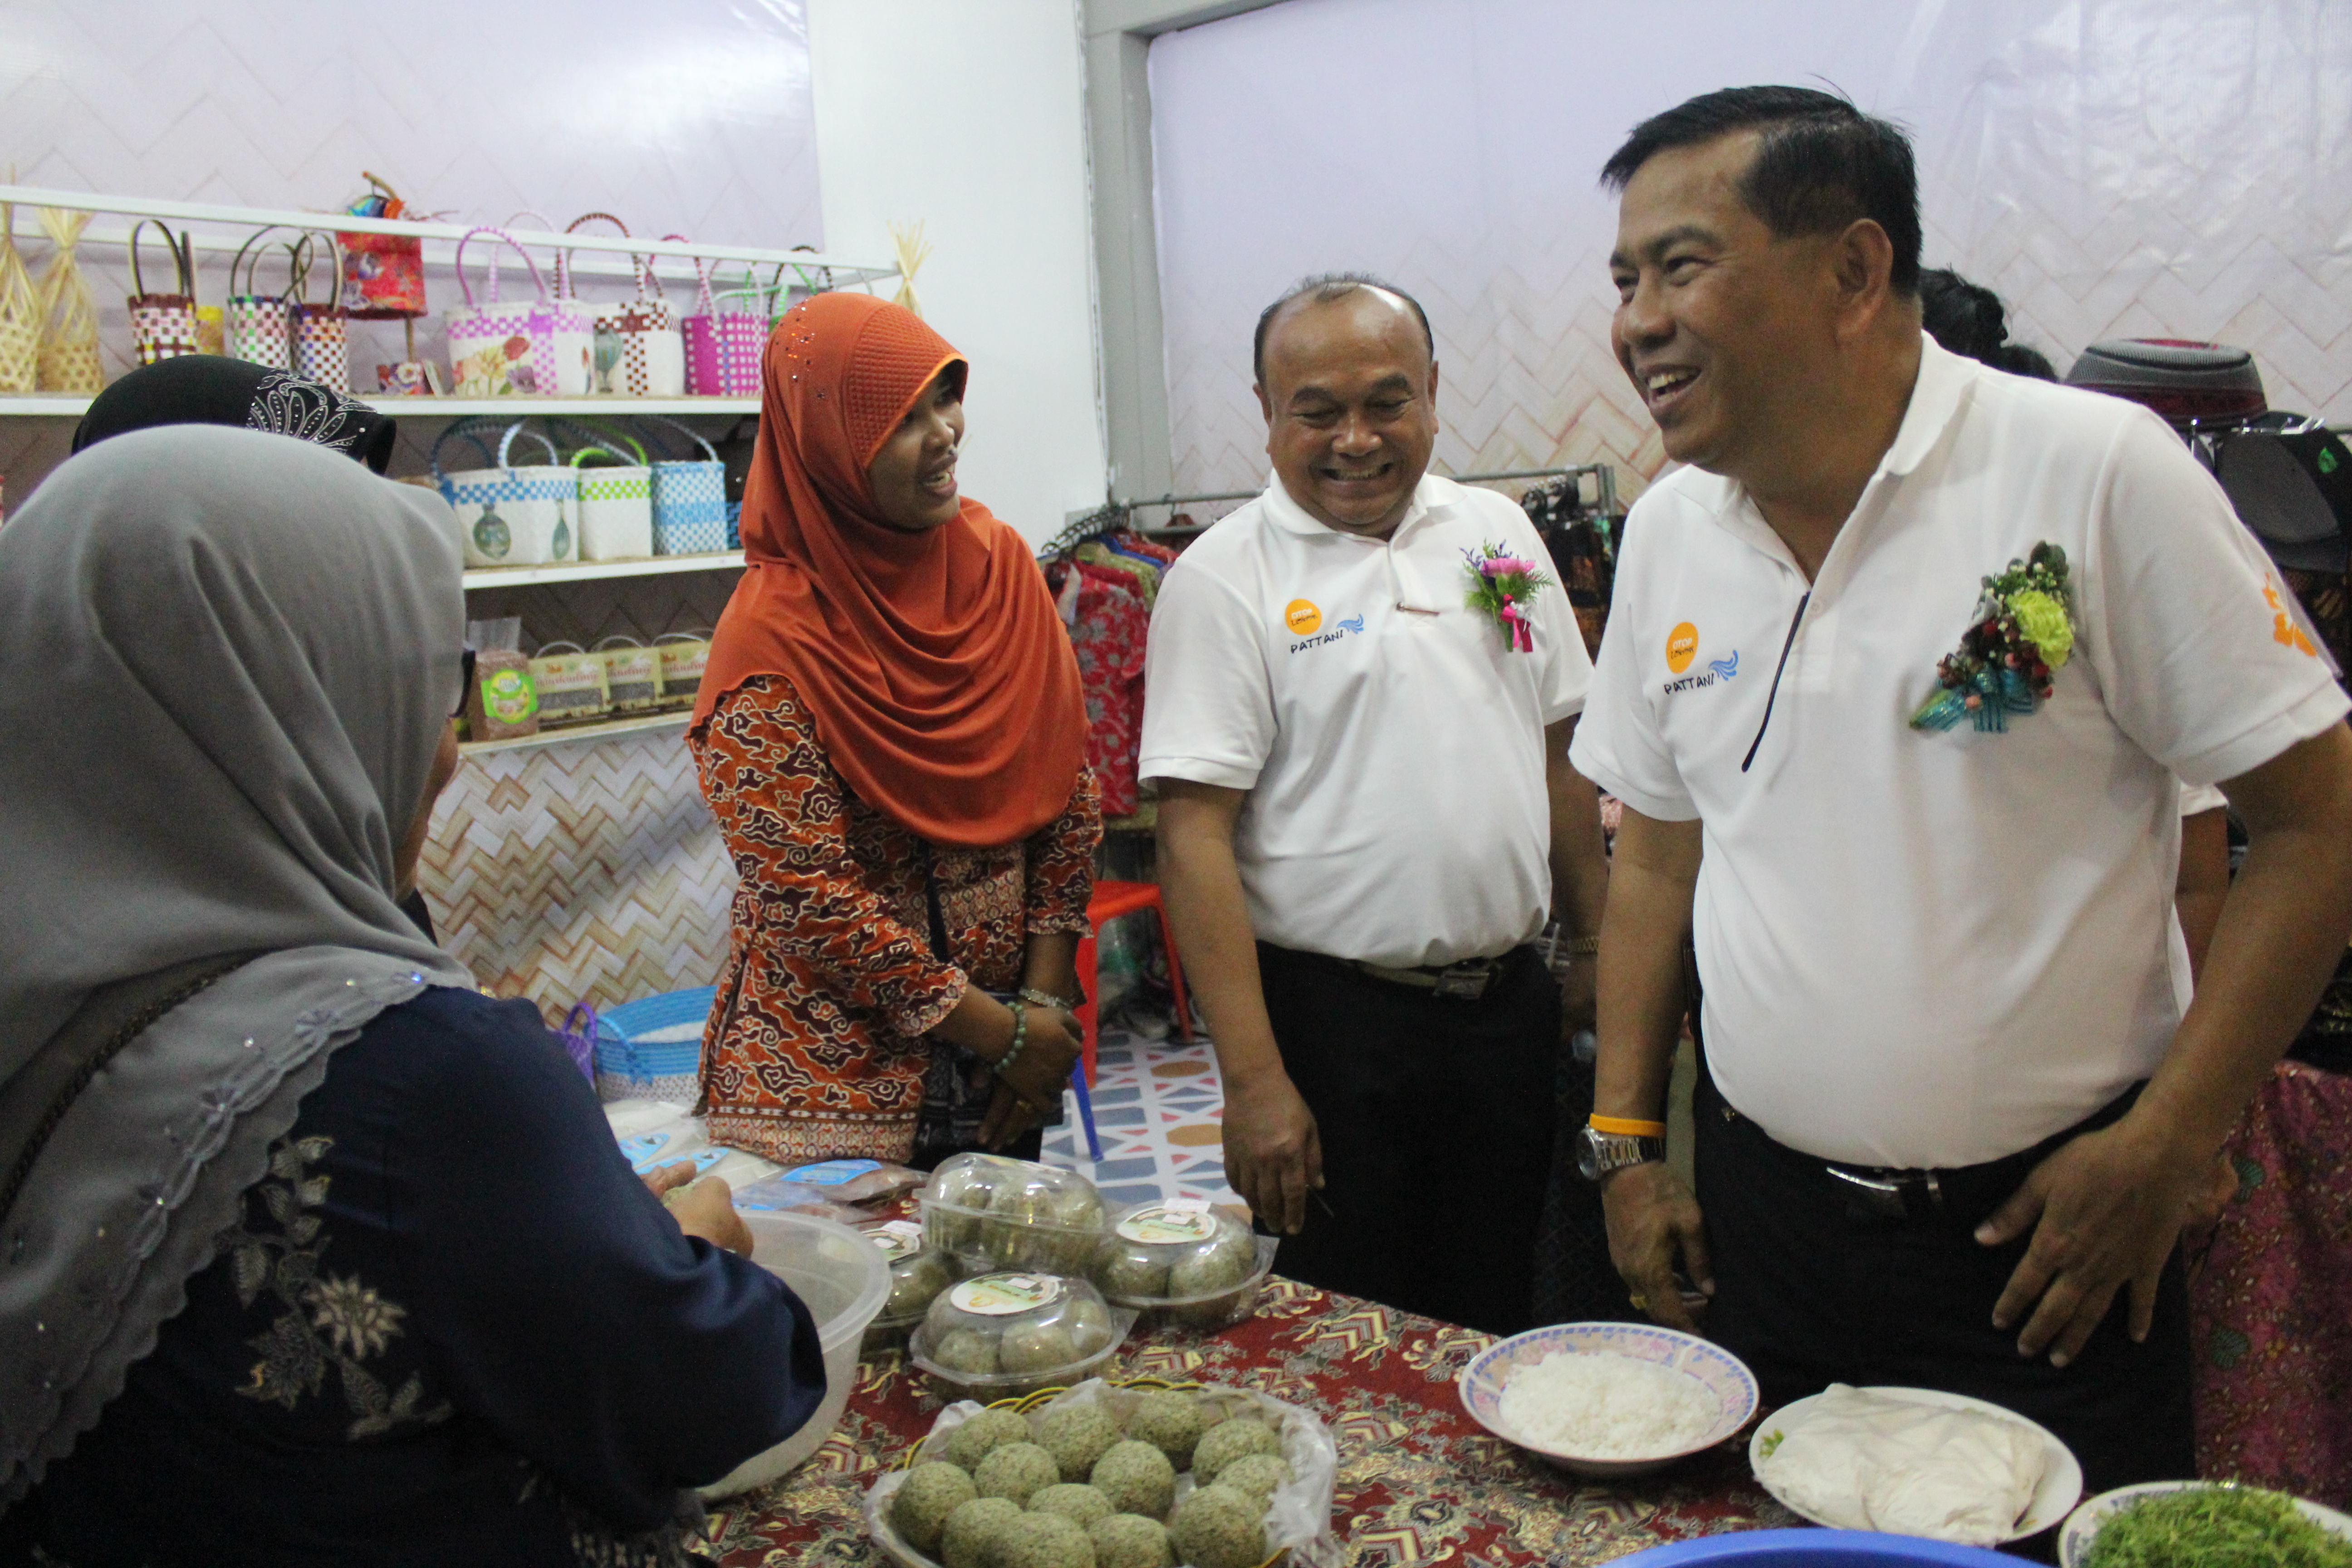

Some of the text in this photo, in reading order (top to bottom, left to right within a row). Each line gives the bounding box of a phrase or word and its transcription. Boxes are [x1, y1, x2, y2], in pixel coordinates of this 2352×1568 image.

[1290, 629, 1343, 654] PATTANI
[1673, 637, 1692, 650] OTOP
[1664, 672, 1714, 695] PATTANI
